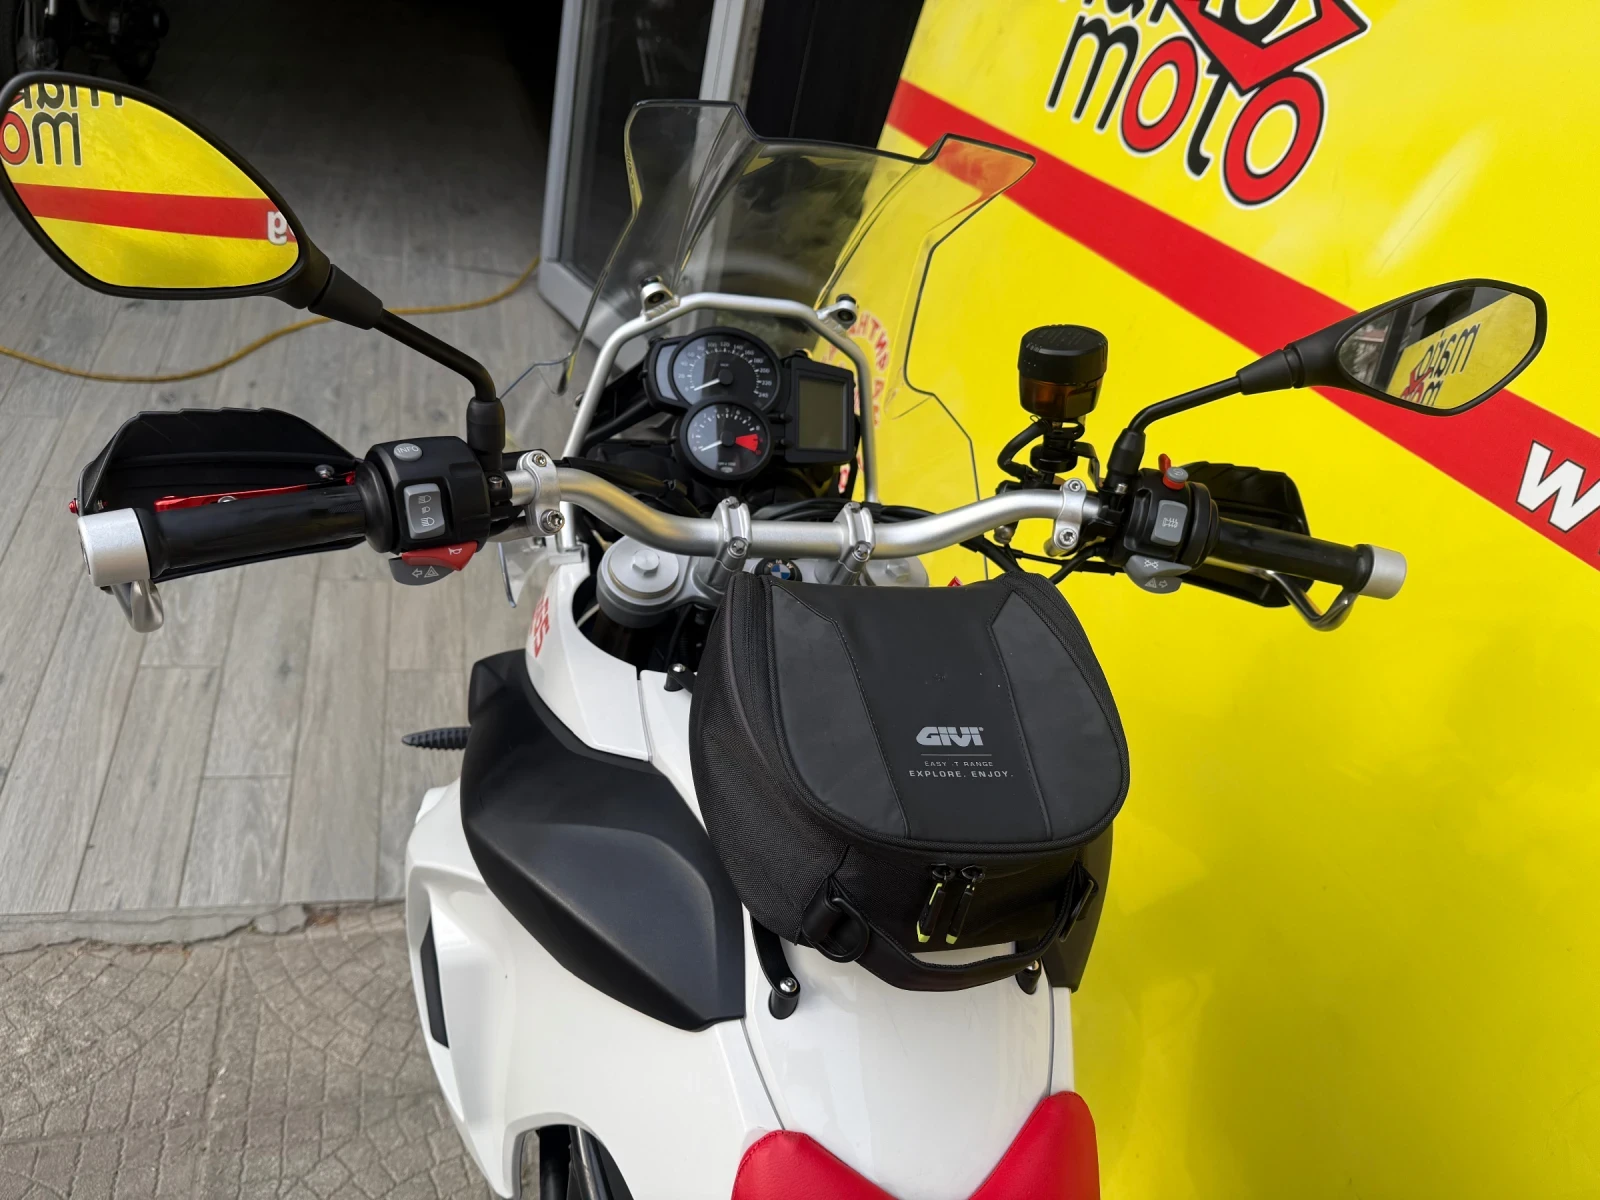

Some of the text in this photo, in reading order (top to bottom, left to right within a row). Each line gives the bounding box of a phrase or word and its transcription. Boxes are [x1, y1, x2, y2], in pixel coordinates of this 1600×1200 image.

[1046, 15, 1325, 206] moto
[396, 446, 419, 454] INFO
[916, 726, 984, 747] GIVI
